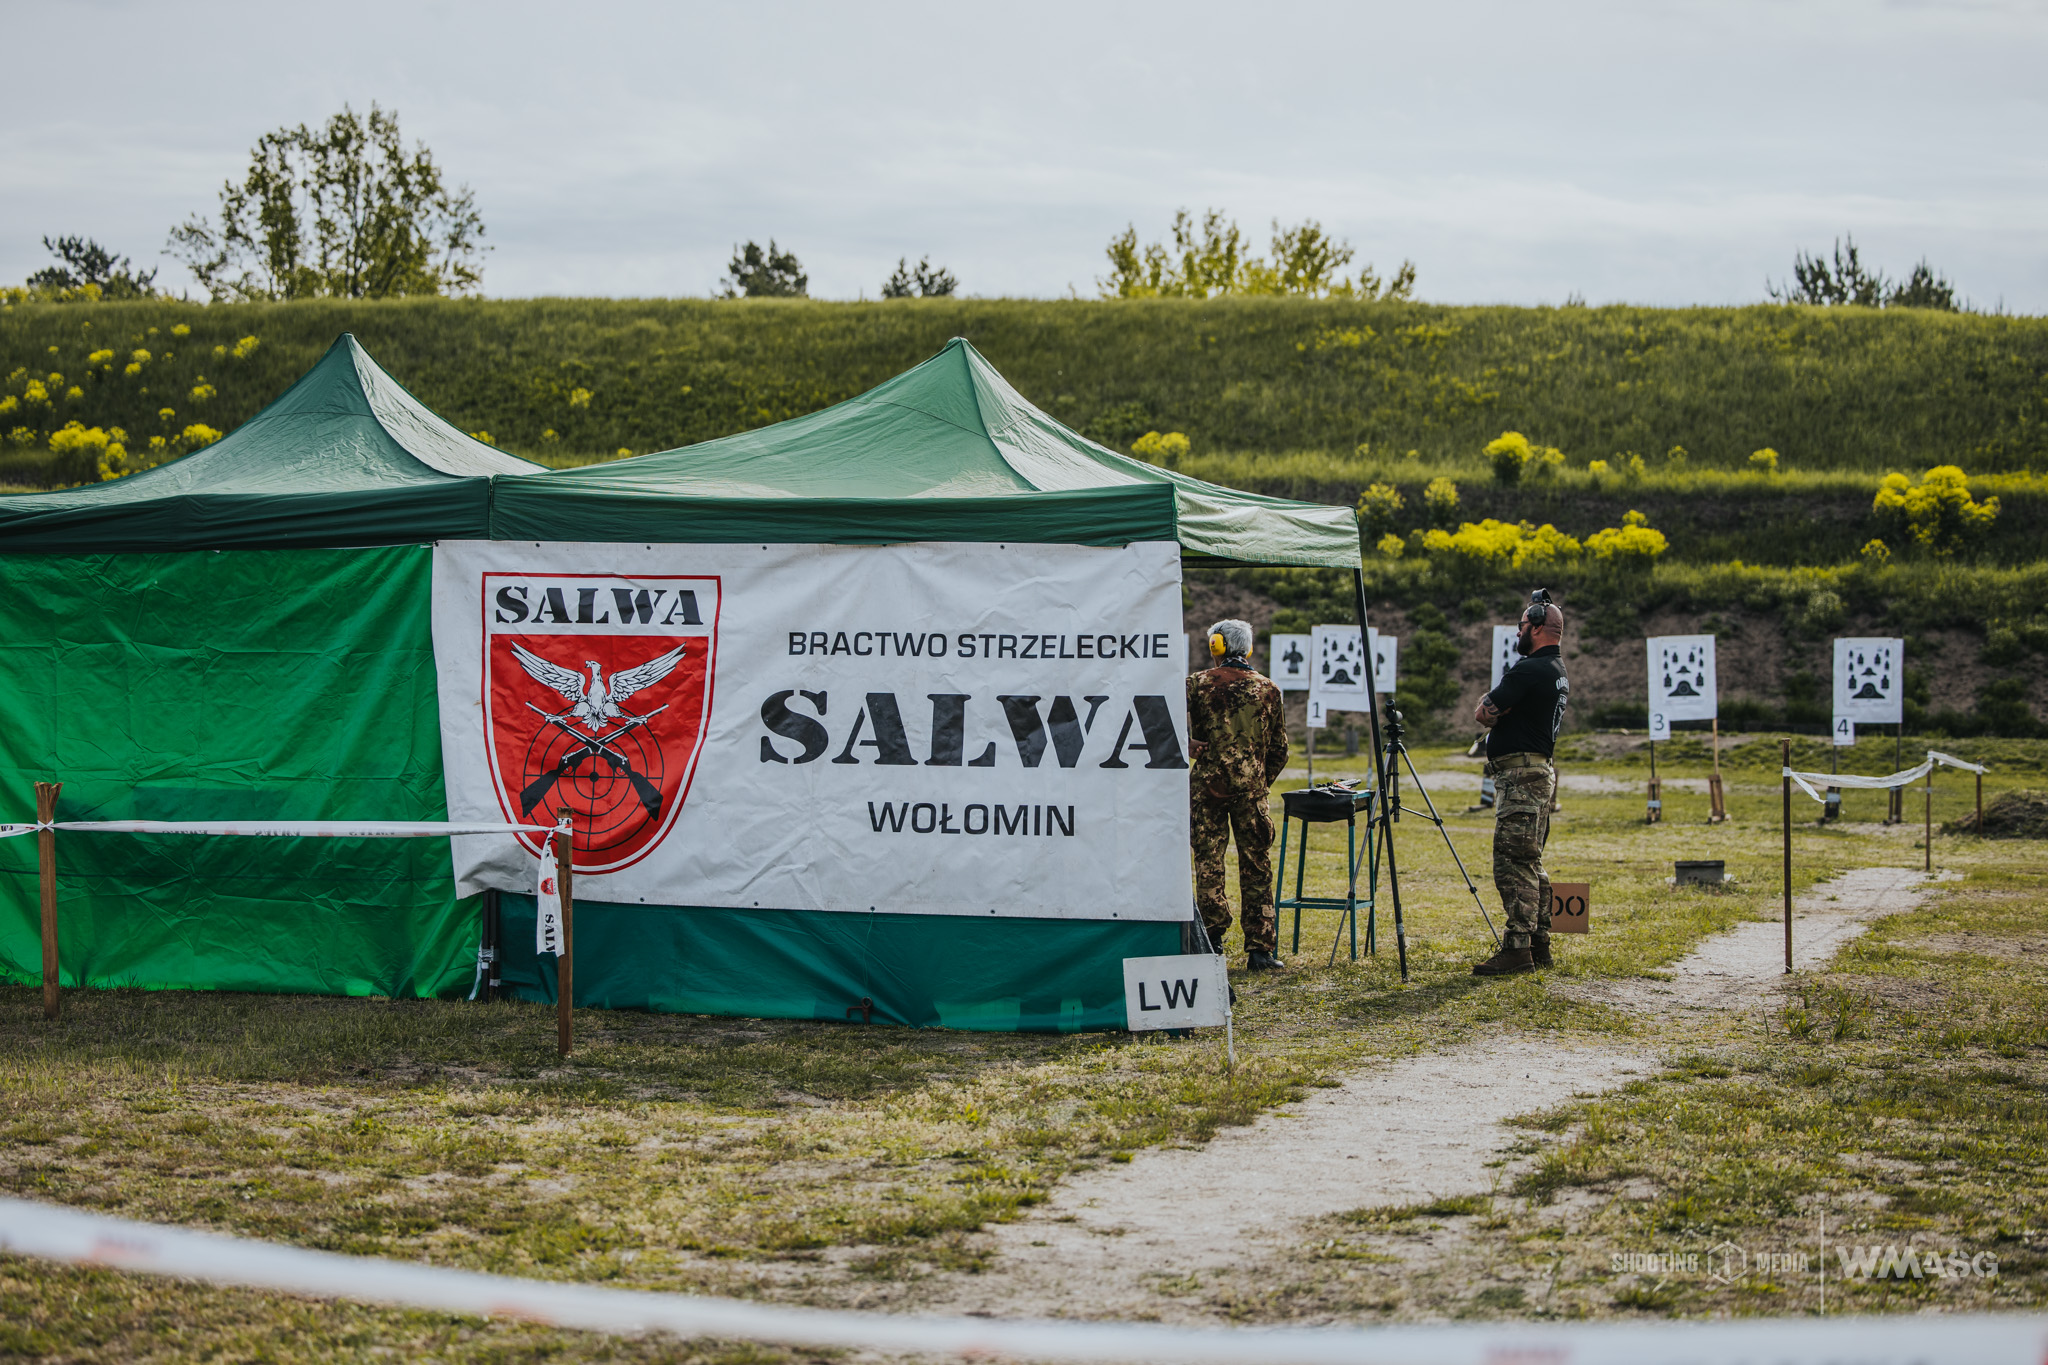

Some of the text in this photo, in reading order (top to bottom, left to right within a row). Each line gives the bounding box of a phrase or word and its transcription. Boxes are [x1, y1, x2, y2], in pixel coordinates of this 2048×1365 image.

[496, 585, 704, 626] SALWA
[788, 631, 1169, 659] BRACTWO STRZELECKIE
[1312, 702, 1320, 718] 1
[1654, 713, 1665, 731] 3
[760, 689, 1189, 769] SALWA
[1838, 718, 1849, 736] 4
[867, 801, 1075, 836] WOŁOMIN
[1138, 978, 1198, 1012] LW
